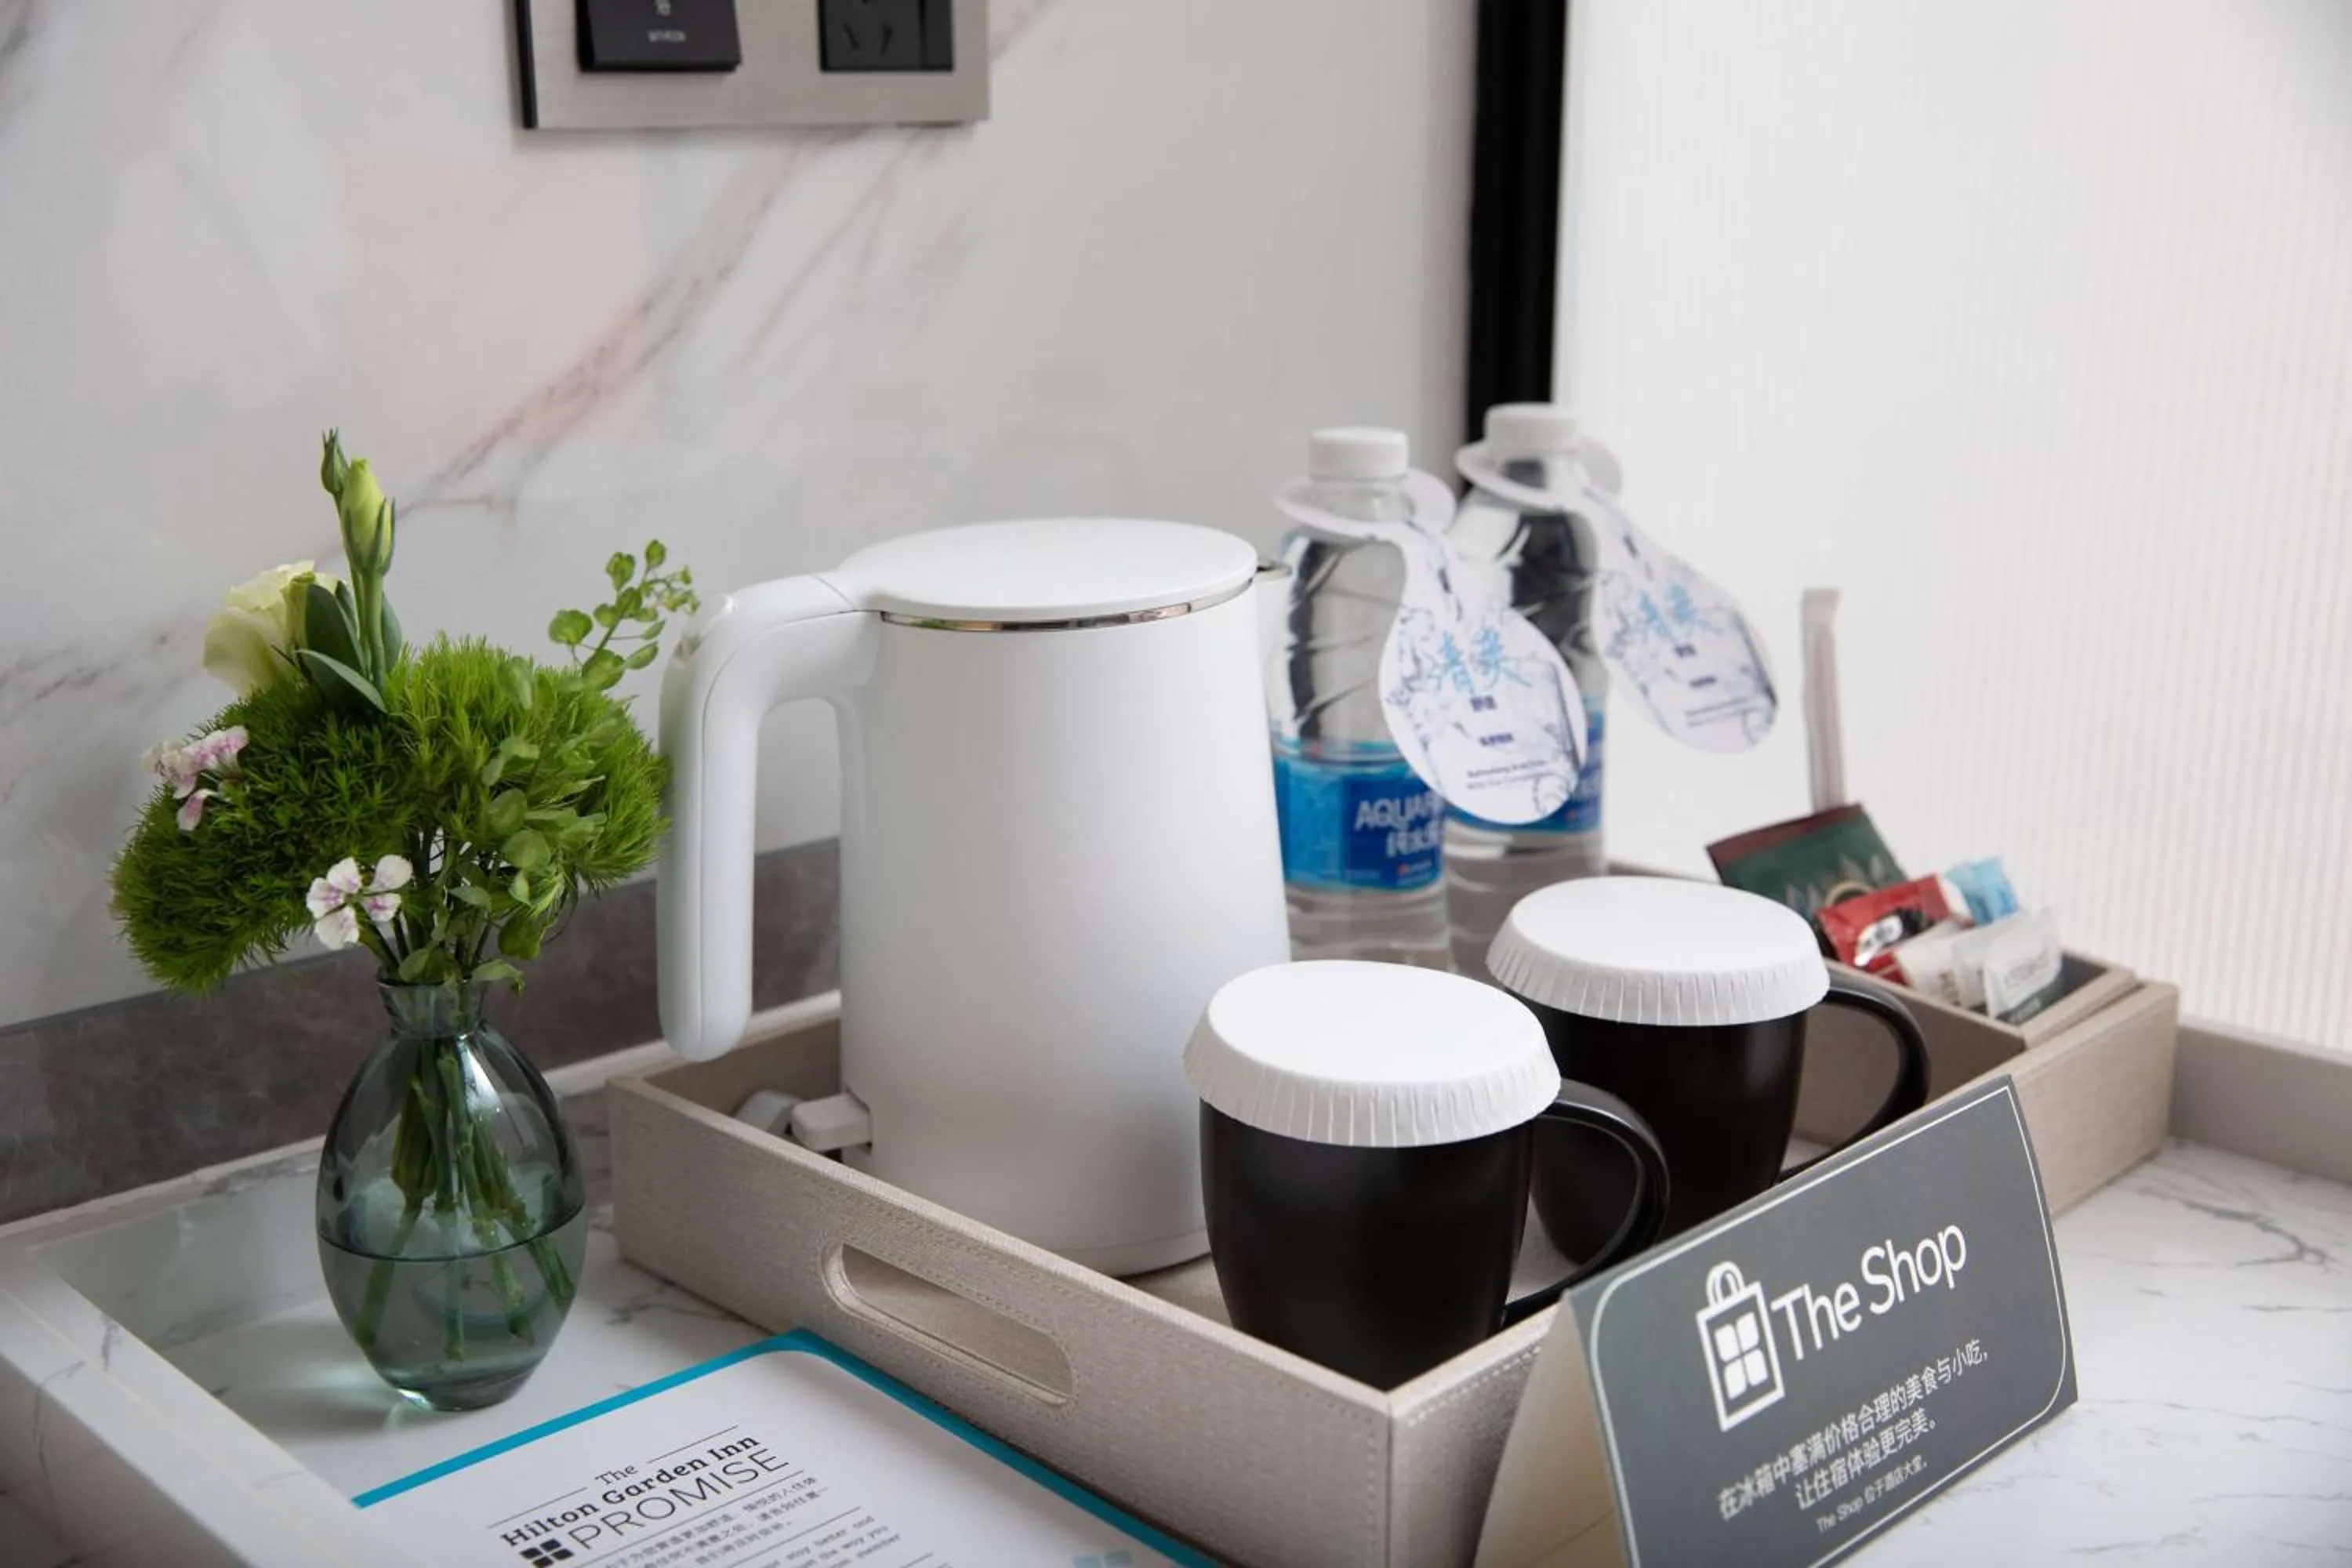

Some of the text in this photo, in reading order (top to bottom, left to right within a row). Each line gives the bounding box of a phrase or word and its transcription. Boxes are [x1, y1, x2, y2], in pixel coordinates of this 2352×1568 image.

[1770, 1225, 1967, 1361] The Shop
[499, 1436, 761, 1547] Hilton Garden Inn
[567, 1448, 789, 1550] PROMISE
[594, 1465, 639, 1486] The
